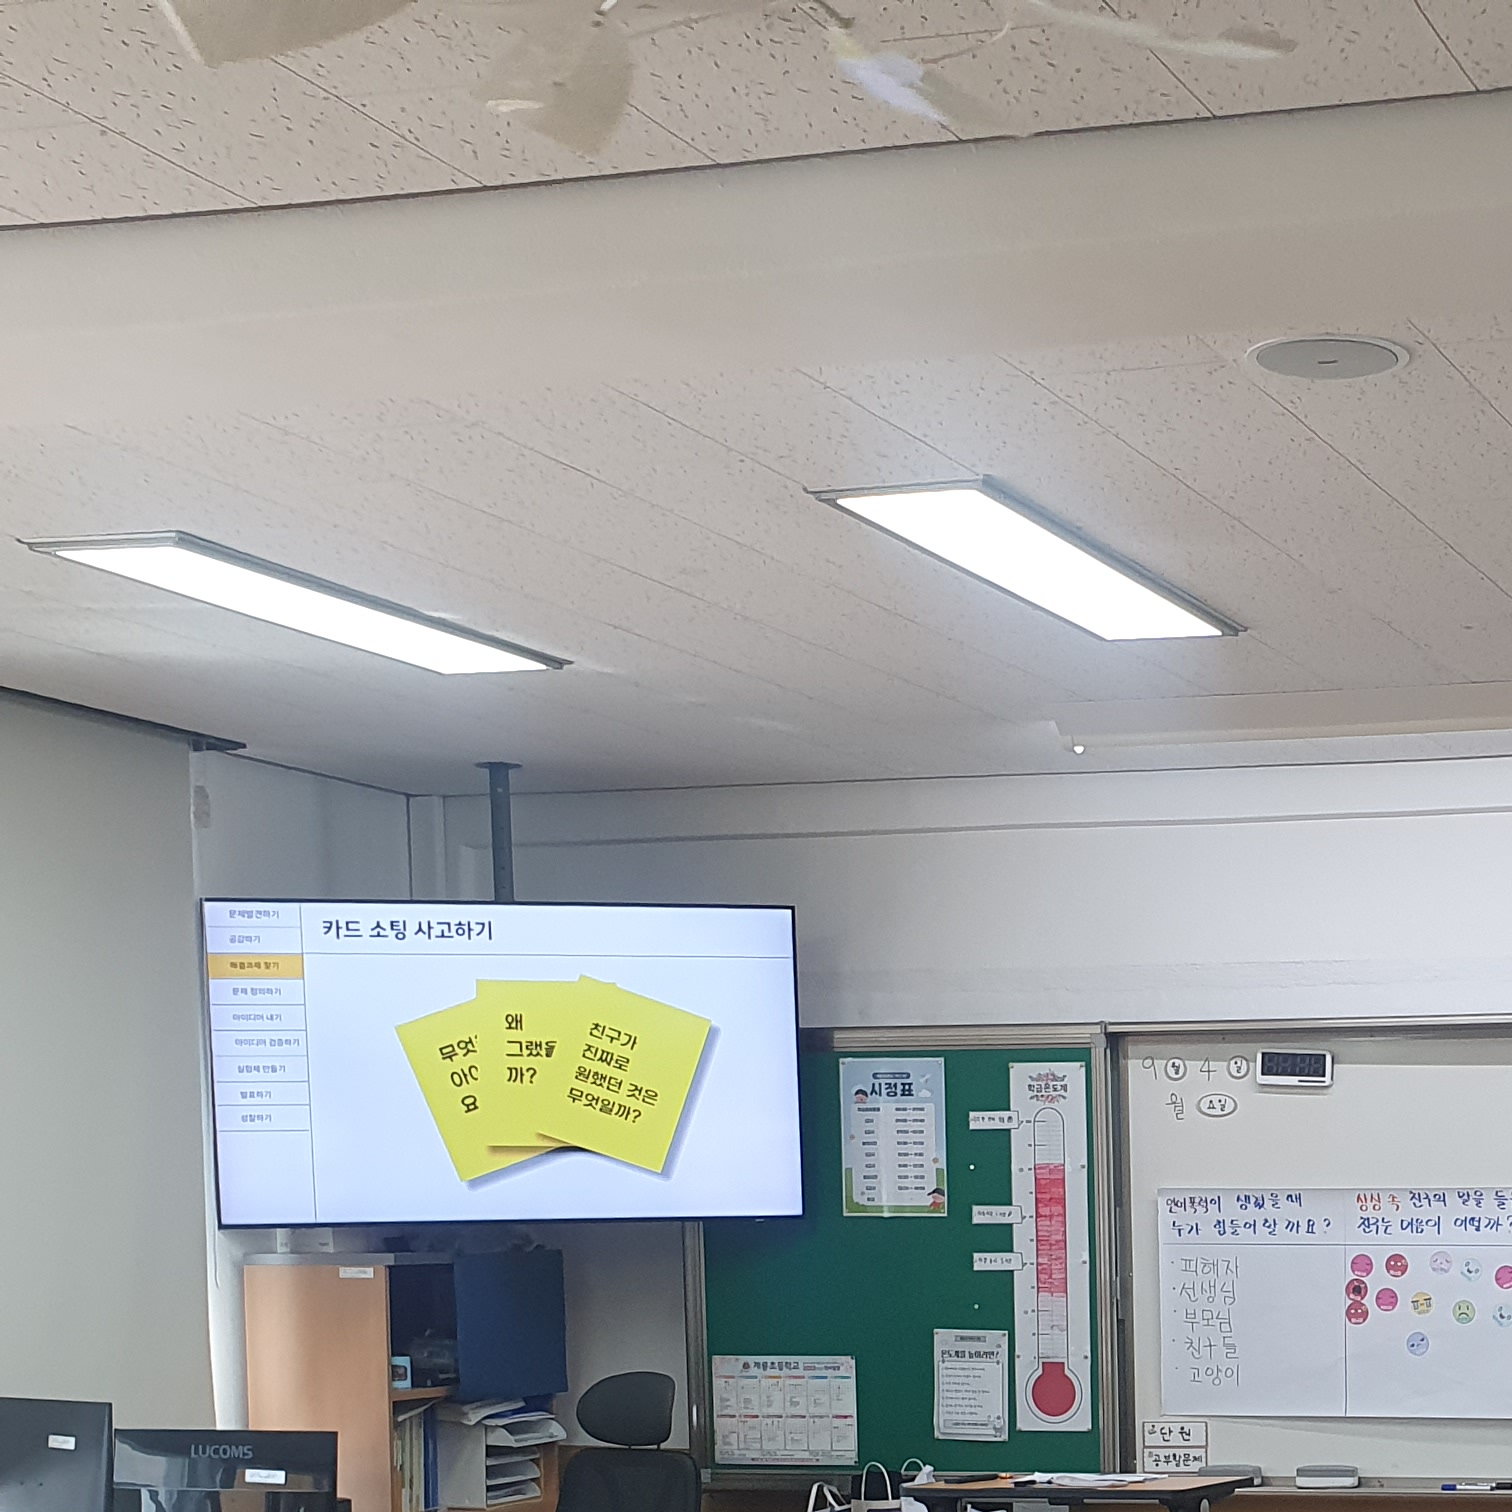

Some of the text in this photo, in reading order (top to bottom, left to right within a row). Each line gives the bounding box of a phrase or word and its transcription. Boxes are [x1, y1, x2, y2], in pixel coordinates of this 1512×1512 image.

[322, 919, 492, 940] 카드 소팅 사고하기
[505, 1013, 523, 1031] 왜
[438, 1034, 478, 1062] 무엇
[589, 1022, 638, 1051] 친구가
[582, 1043, 630, 1072] 진짜로
[1142, 1056, 1158, 1080] 9
[1199, 1057, 1217, 1082] 4
[506, 1066, 538, 1085] 까?
[575, 1065, 659, 1106] 원했던 것은
[869, 1082, 915, 1098] 시정표
[567, 1087, 643, 1124] 무엇일까?
[1165, 1092, 1185, 1121] 월
[1409, 1190, 1447, 1209] 친구의
[1456, 1190, 1484, 1209] 말을
[1171, 1220, 1202, 1238] 누가
[1180, 1256, 1239, 1279] 피해자
[1180, 1279, 1236, 1306] 선생님
[1183, 1308, 1232, 1334] 부모님
[1189, 1364, 1239, 1387] 고양이
[190, 1443, 254, 1460] LUCOMS
